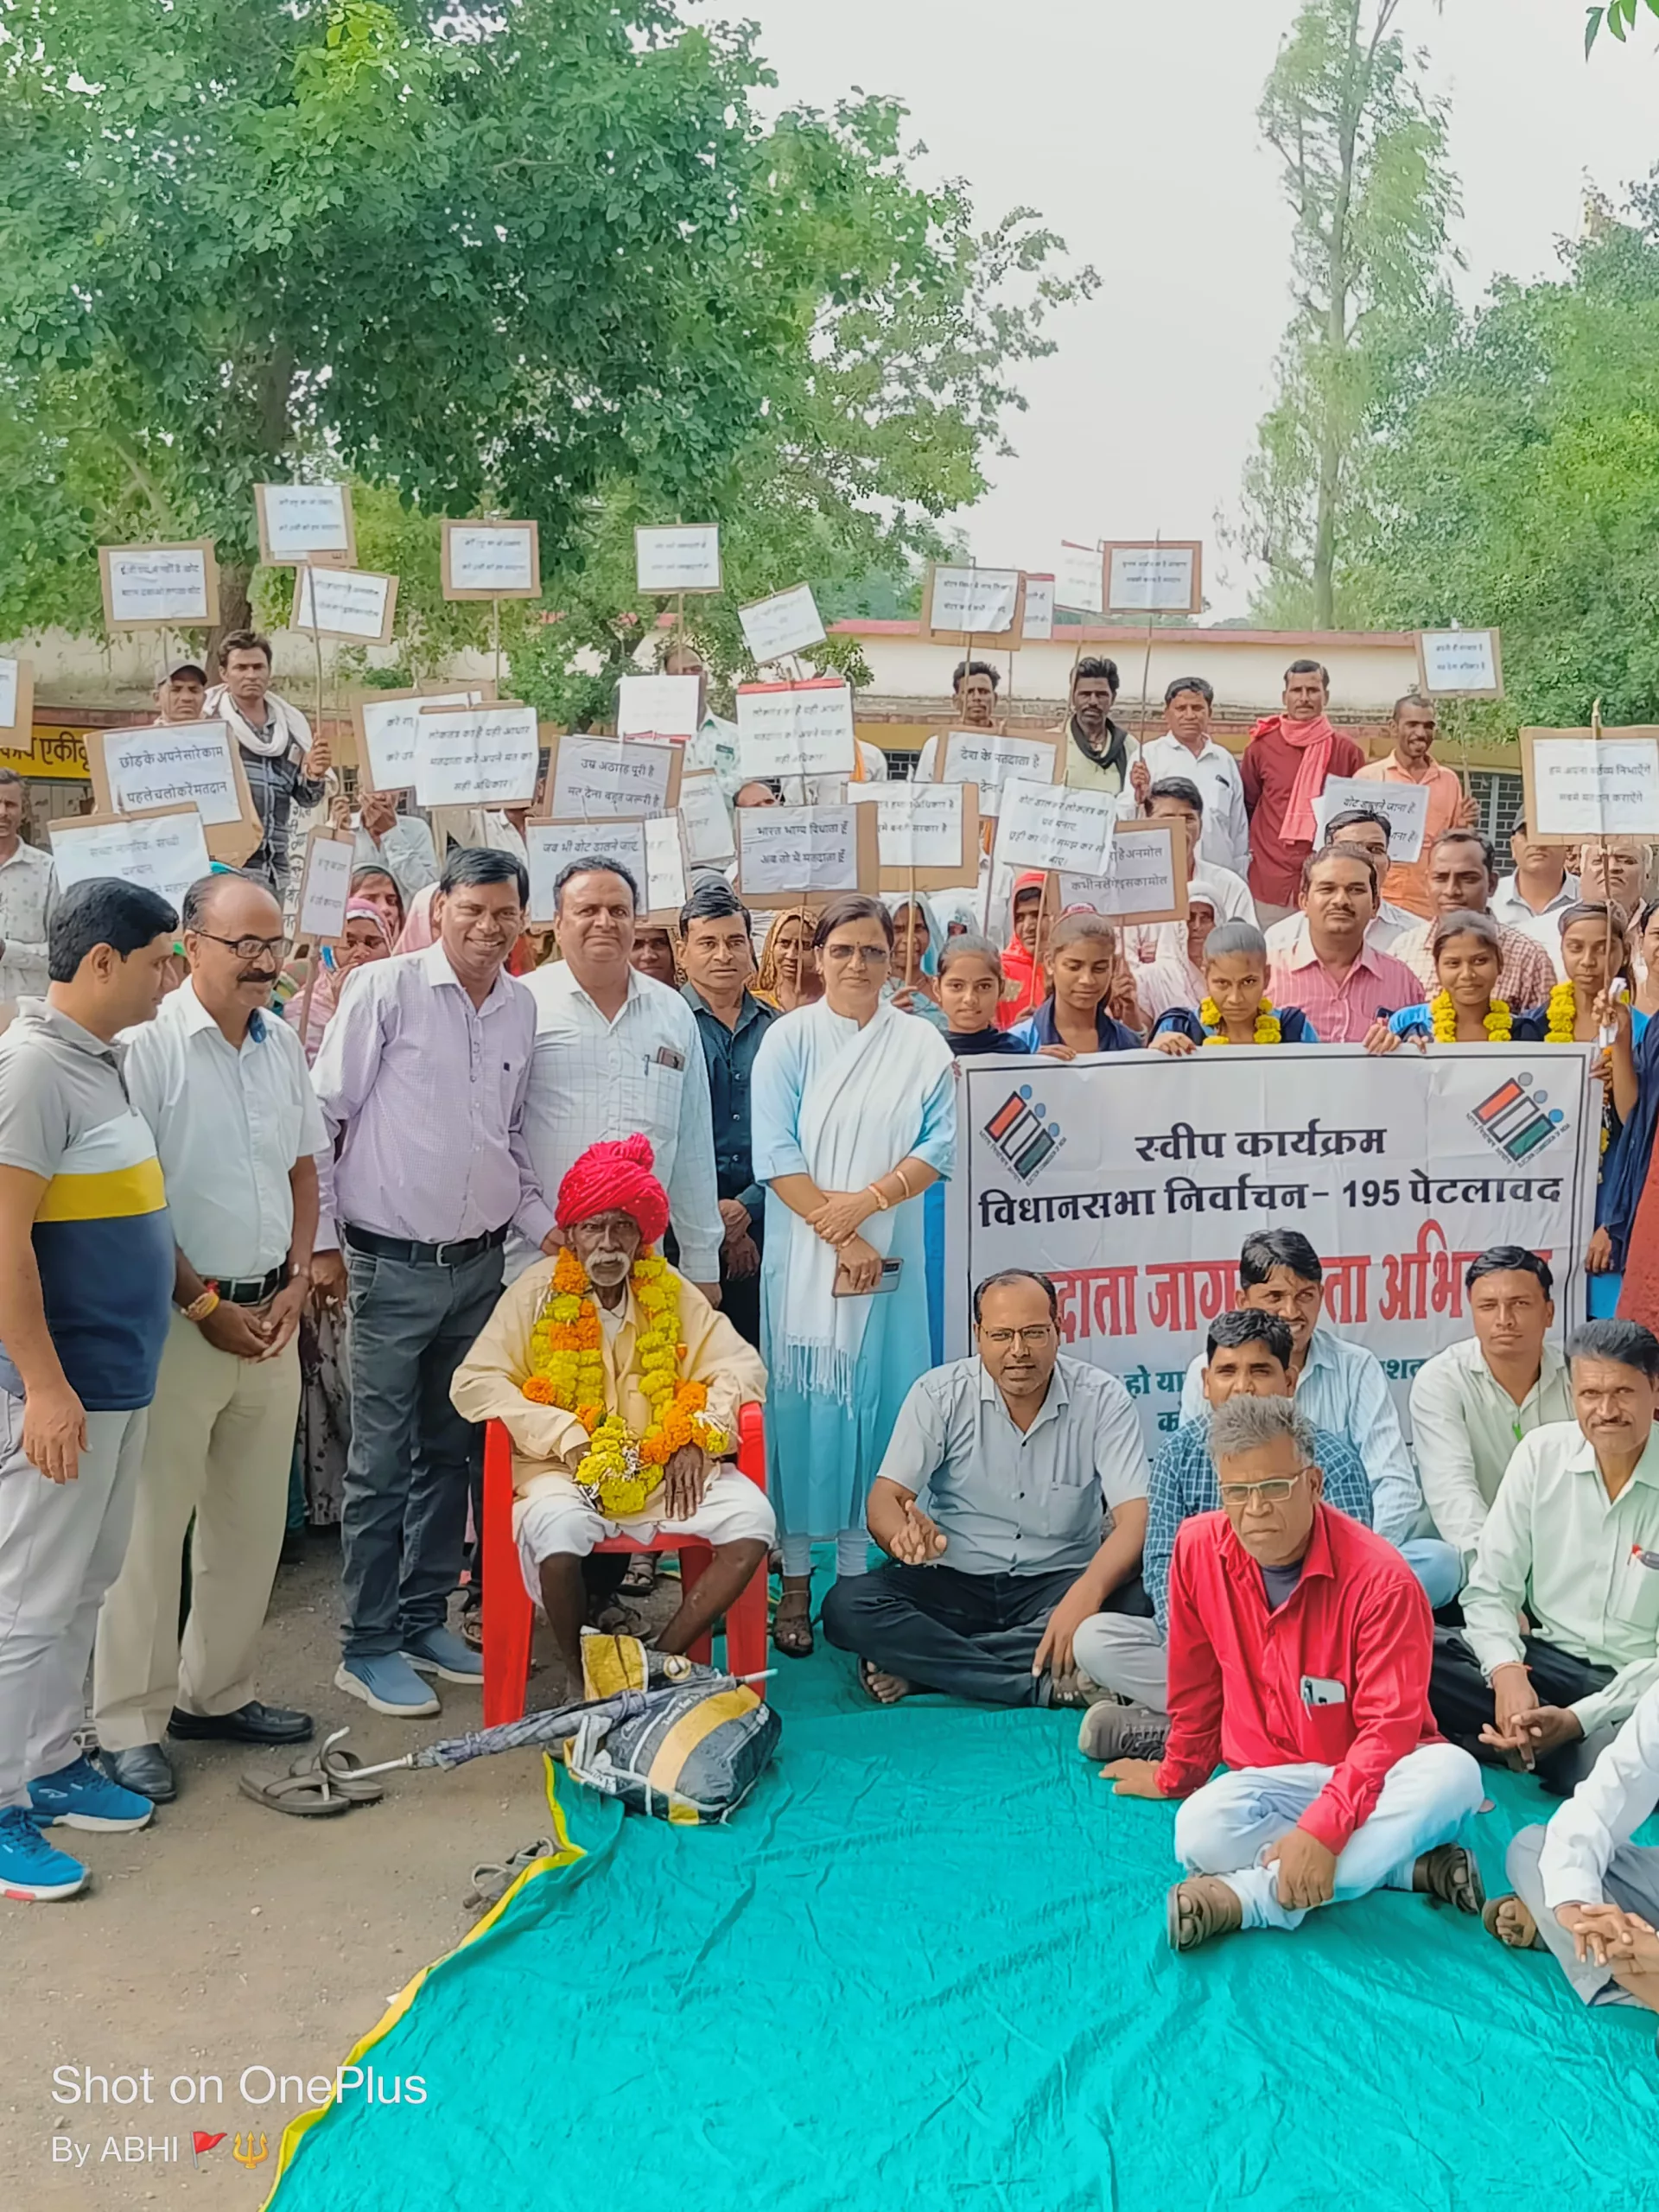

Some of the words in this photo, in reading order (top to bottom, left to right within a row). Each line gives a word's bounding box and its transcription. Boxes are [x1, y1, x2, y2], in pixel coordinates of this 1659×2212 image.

[1135, 1122, 1227, 1162] स्वीप
[1234, 1118, 1388, 1159] कार्यक्रम
[978, 1188, 1156, 1227] विधानसभा
[1343, 1179, 1400, 1208] 195
[1409, 1168, 1565, 1205] पेटलावद
[1043, 1265, 1139, 1344] दाता
